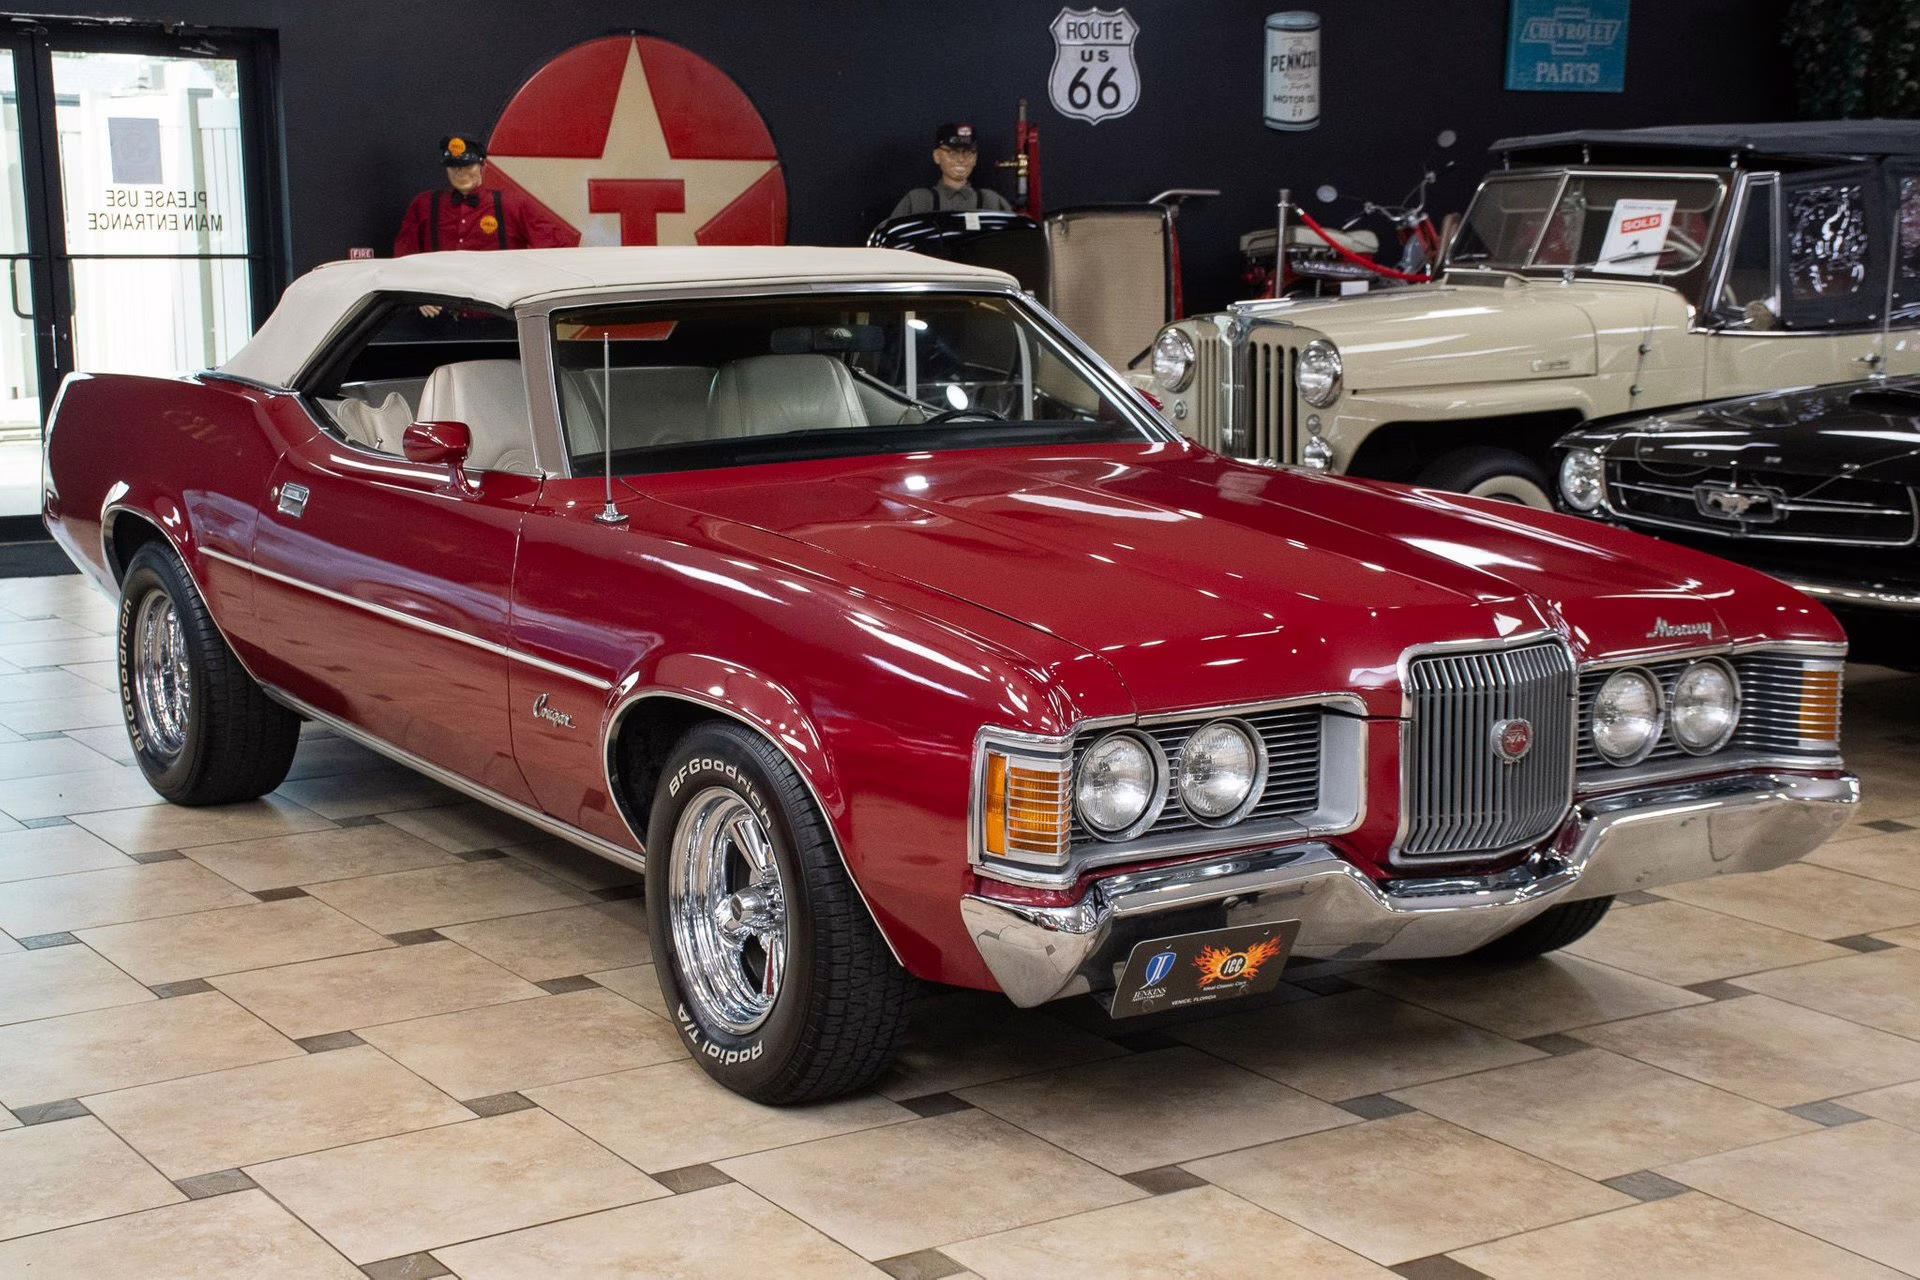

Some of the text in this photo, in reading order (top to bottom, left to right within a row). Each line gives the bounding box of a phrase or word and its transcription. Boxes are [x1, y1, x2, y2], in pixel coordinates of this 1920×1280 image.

[1066, 21, 1123, 40] ROUTE
[1529, 21, 1615, 40] CHEVROLET
[1081, 49, 1109, 62] US
[1535, 62, 1600, 84] PARTS
[1068, 66, 1120, 110] 66
[1273, 95, 1305, 104] MOTOR
[1622, 215, 1660, 232] SOLD
[1646, 616, 1713, 640] Mercury
[119, 599, 145, 752] BFGoodrich
[533, 692, 577, 729] Cougar
[669, 758, 771, 829] BFGoodrich
[1133, 986, 1167, 999] JENKINS
[1193, 994, 1217, 1003] FLORIDA
[678, 1003, 764, 1066] Radial T/A
